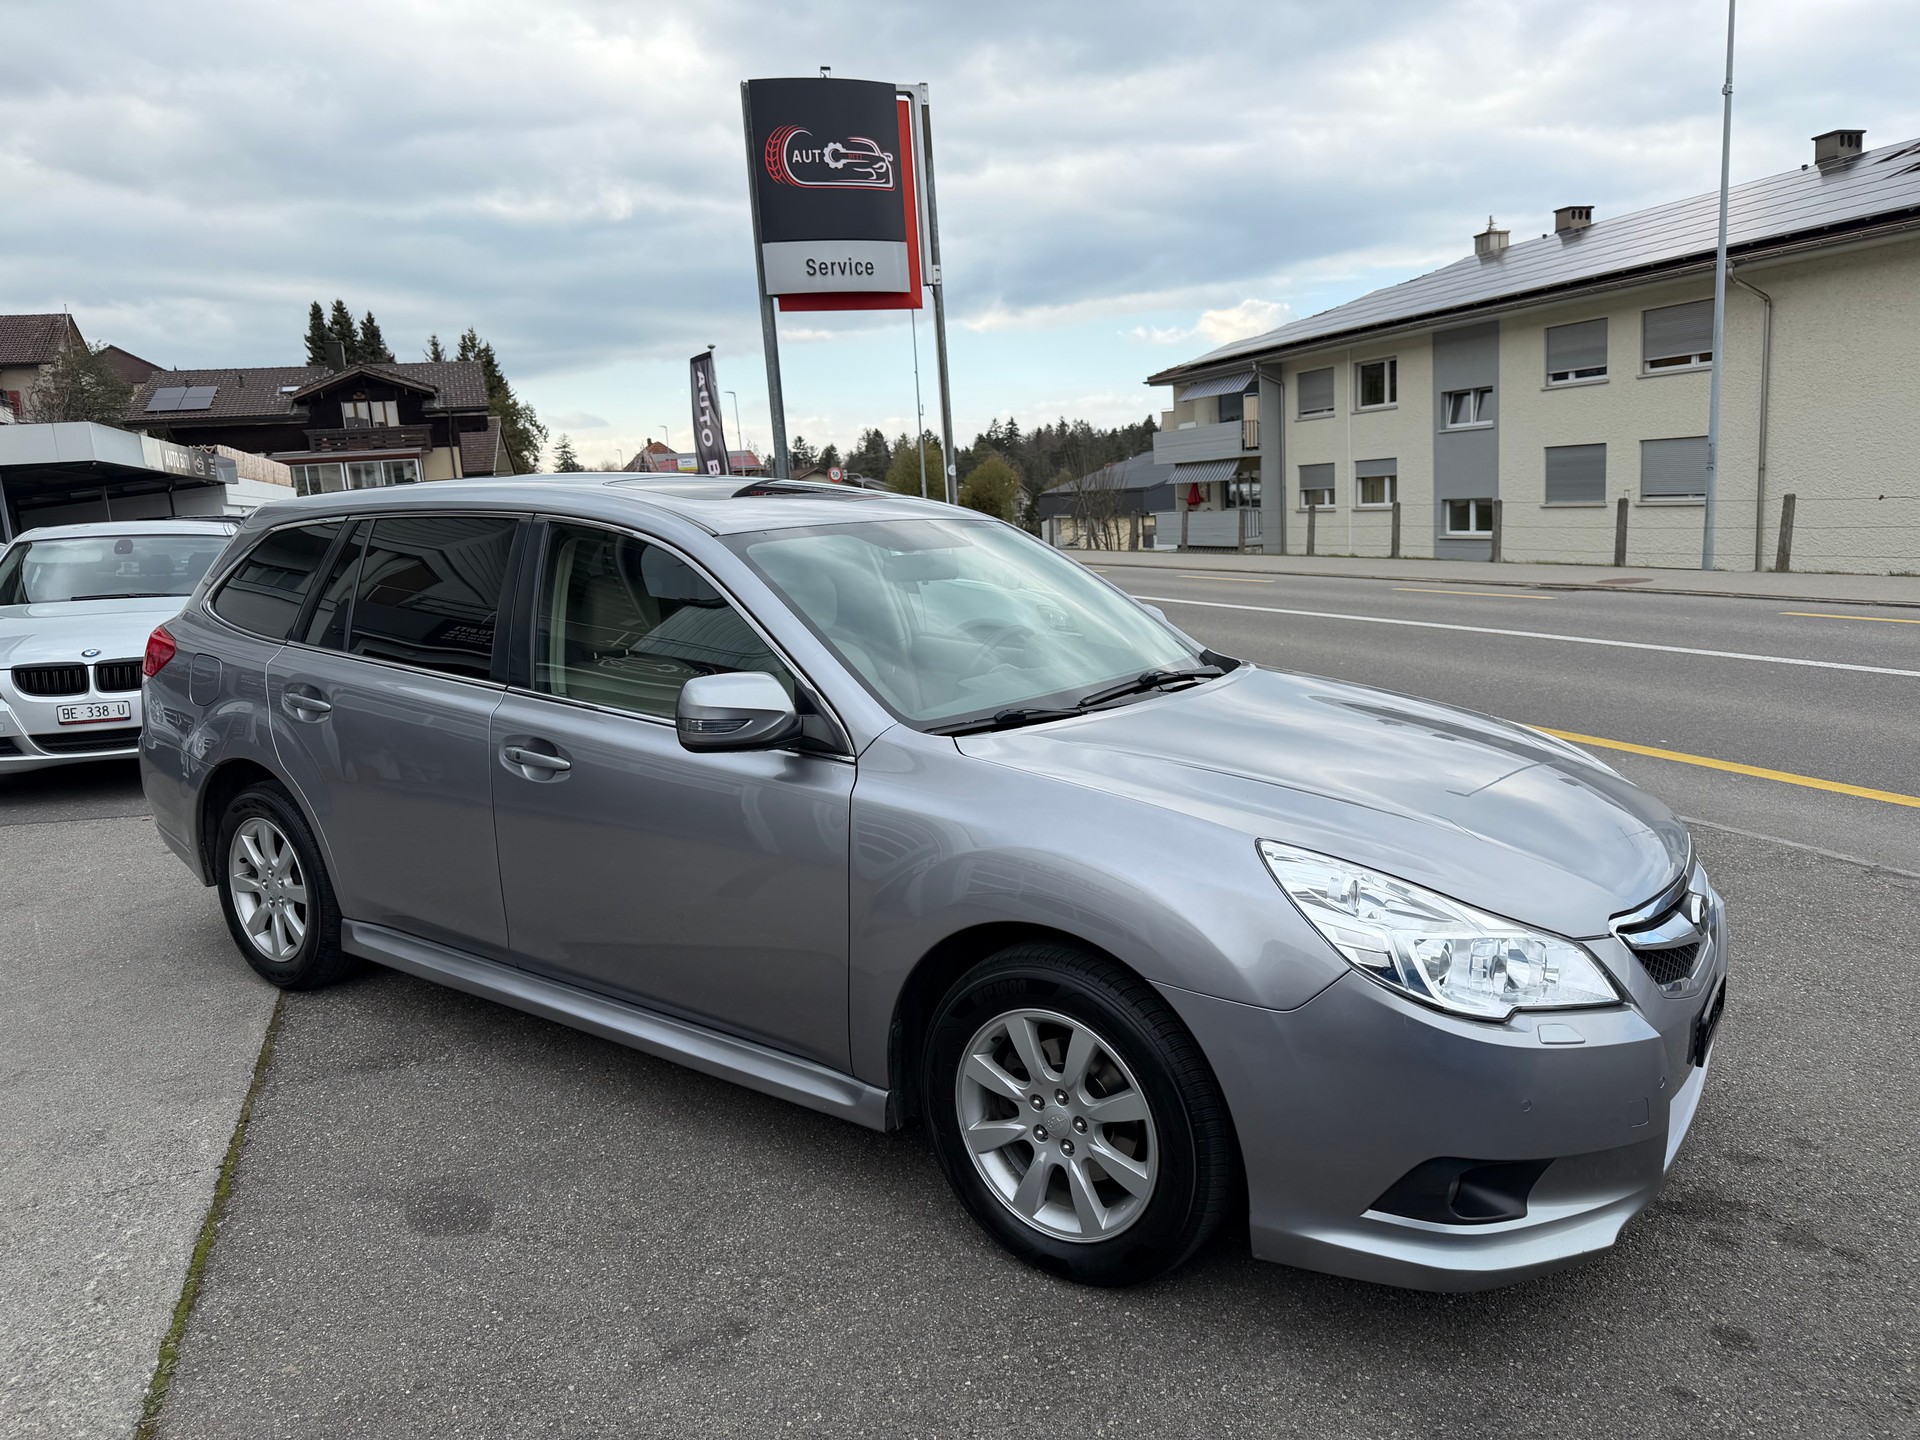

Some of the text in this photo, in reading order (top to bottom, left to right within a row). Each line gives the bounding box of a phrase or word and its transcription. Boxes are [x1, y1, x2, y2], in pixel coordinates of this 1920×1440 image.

[806, 257, 875, 277] Service
[697, 371, 713, 447] AUTO
[831, 471, 840, 479] 50
[62, 704, 125, 720] BE 338 U
